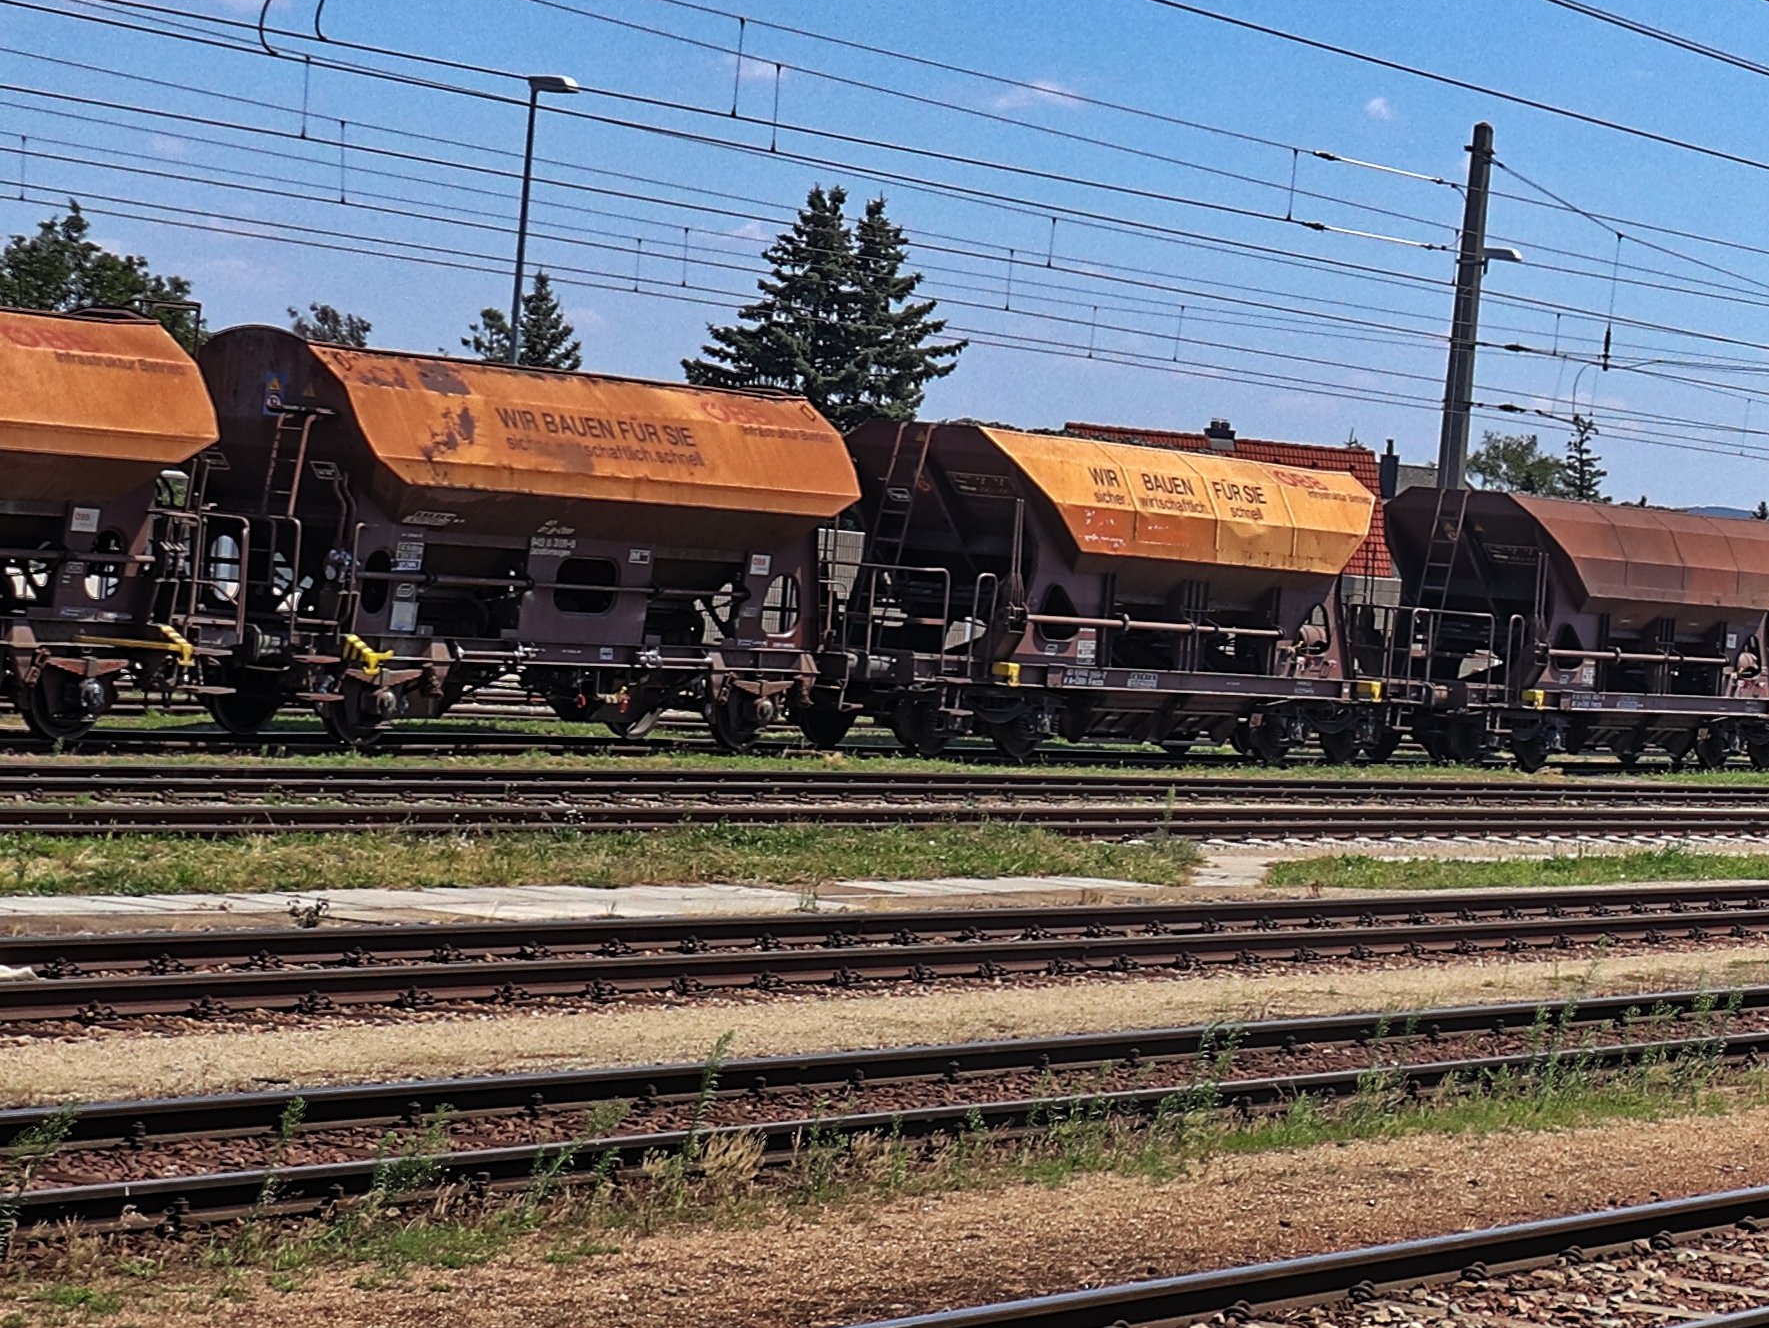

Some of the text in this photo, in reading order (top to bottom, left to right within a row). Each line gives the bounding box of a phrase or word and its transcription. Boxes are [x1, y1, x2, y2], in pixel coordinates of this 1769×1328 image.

[494, 407, 698, 448] WIR BAUEN FÜR SIE
[1088, 466, 1268, 505] WIR BAUEN FÜR SIE
